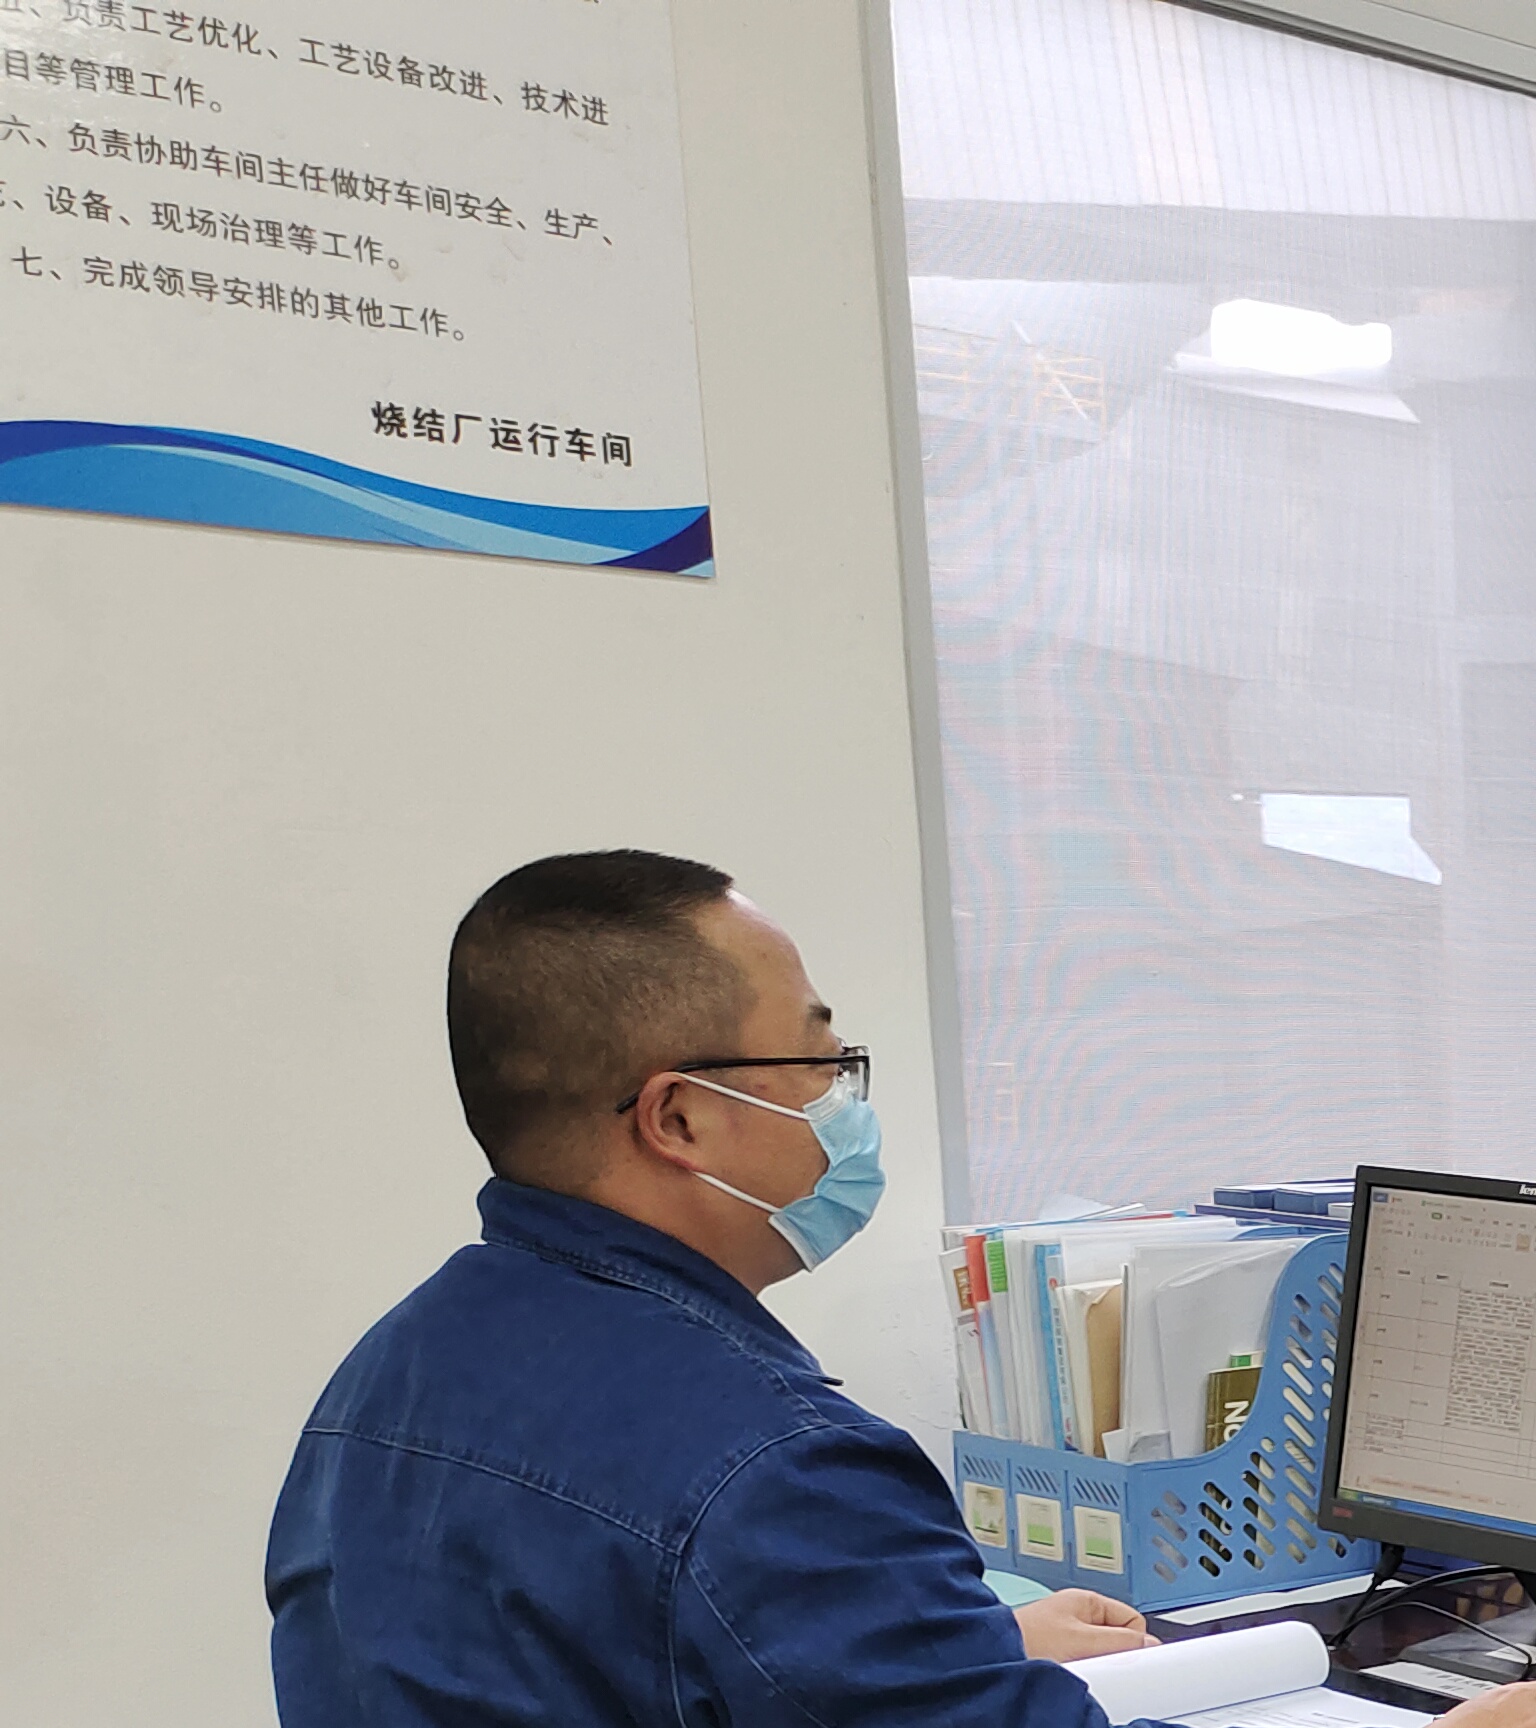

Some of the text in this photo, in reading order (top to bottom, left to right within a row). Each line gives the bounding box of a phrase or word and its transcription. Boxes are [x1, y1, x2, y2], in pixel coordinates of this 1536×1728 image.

[4, 48, 223, 114] 目等管理工作。
[0, 114, 613, 247] 六、负责协助车间主任做好车间安全、生产、
[0, 180, 402, 272] 、设备、现场治理等工作。
[12, 246, 466, 342] 七、完成领导安排的其他工作。
[371, 400, 634, 468] 烧结厂运行车间
